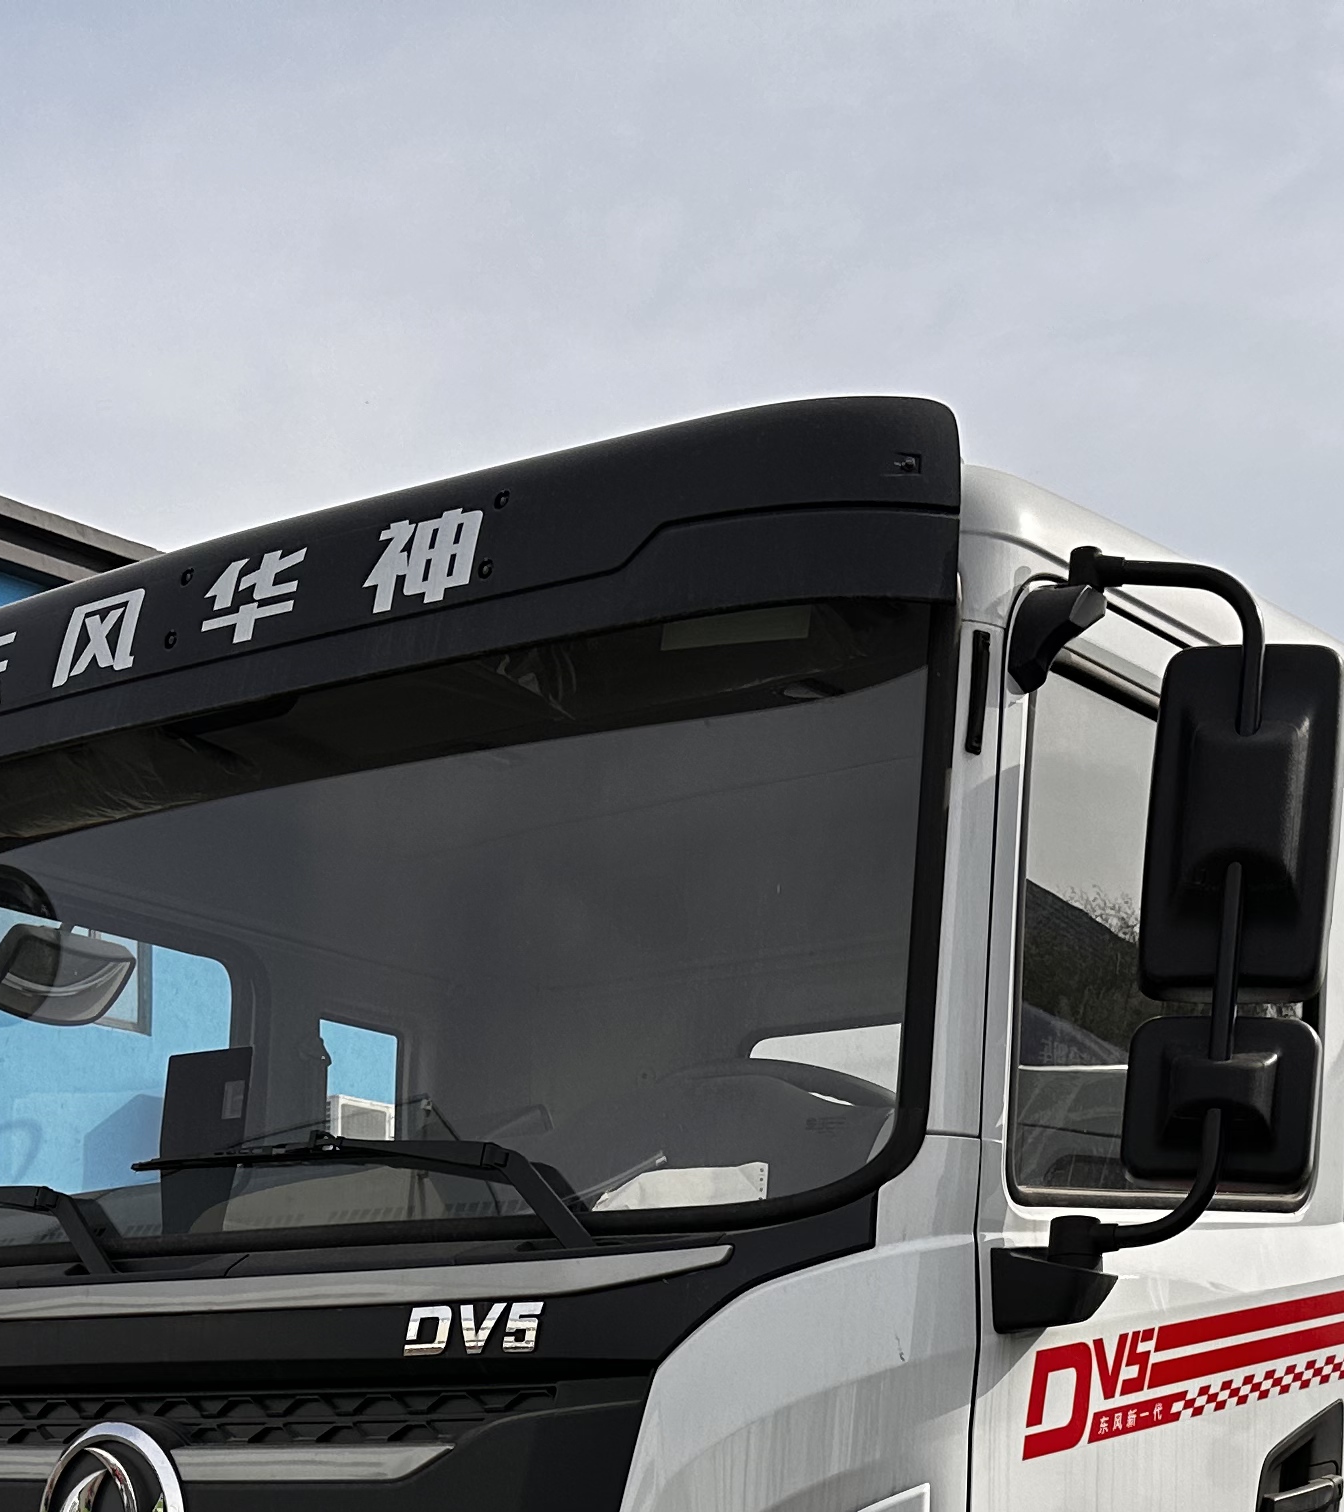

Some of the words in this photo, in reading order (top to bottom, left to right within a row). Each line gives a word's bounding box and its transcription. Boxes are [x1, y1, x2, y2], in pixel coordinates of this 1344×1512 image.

[403, 1301, 545, 1357] DV5
[1097, 1402, 1164, 1435] 东风新一代
